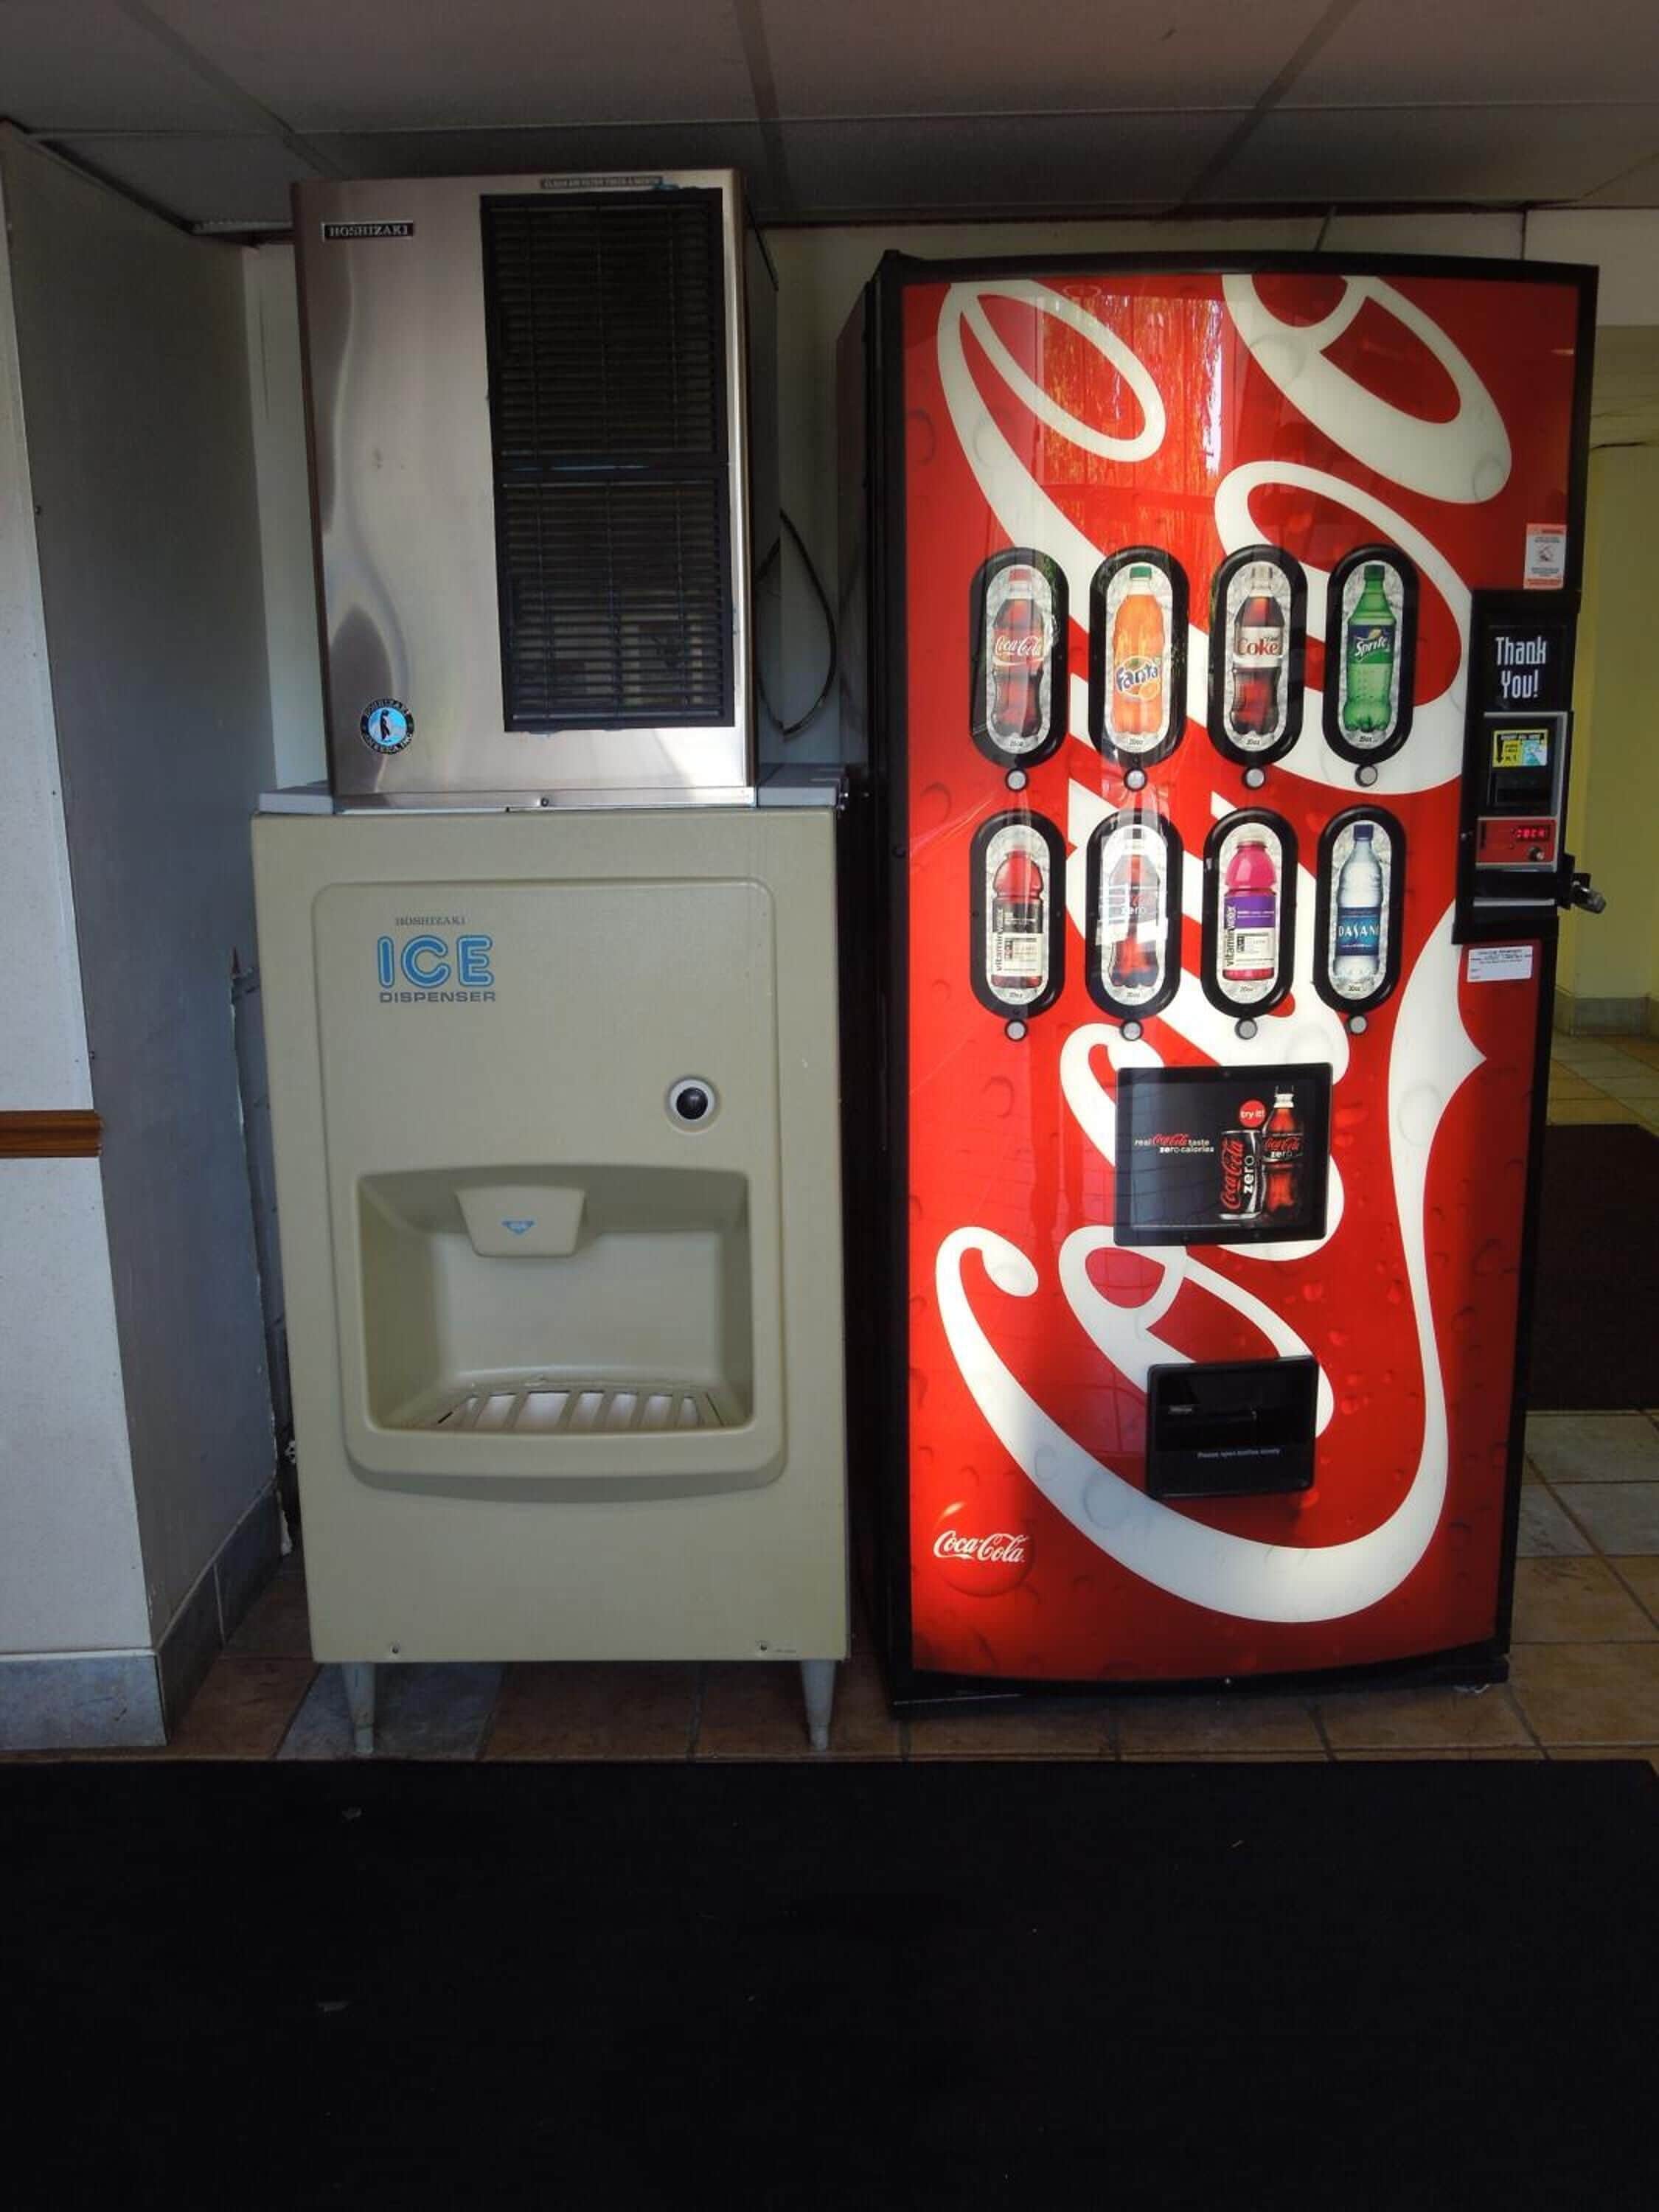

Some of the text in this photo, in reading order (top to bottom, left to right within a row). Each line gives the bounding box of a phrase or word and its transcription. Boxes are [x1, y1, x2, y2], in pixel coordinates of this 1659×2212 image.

[327, 224, 408, 237] HOSHIZAKI
[1237, 638, 1279, 655] Coke
[1354, 636, 1388, 662] Sprite
[1495, 635, 1547, 666] Thank
[1116, 663, 1158, 692] Fanta
[1500, 669, 1539, 699] You!
[377, 934, 495, 989] ICE
[379, 991, 496, 1004] DISPENSER
[1244, 1155, 1255, 1194] zero
[933, 1530, 1031, 1562] Coca-Cola
